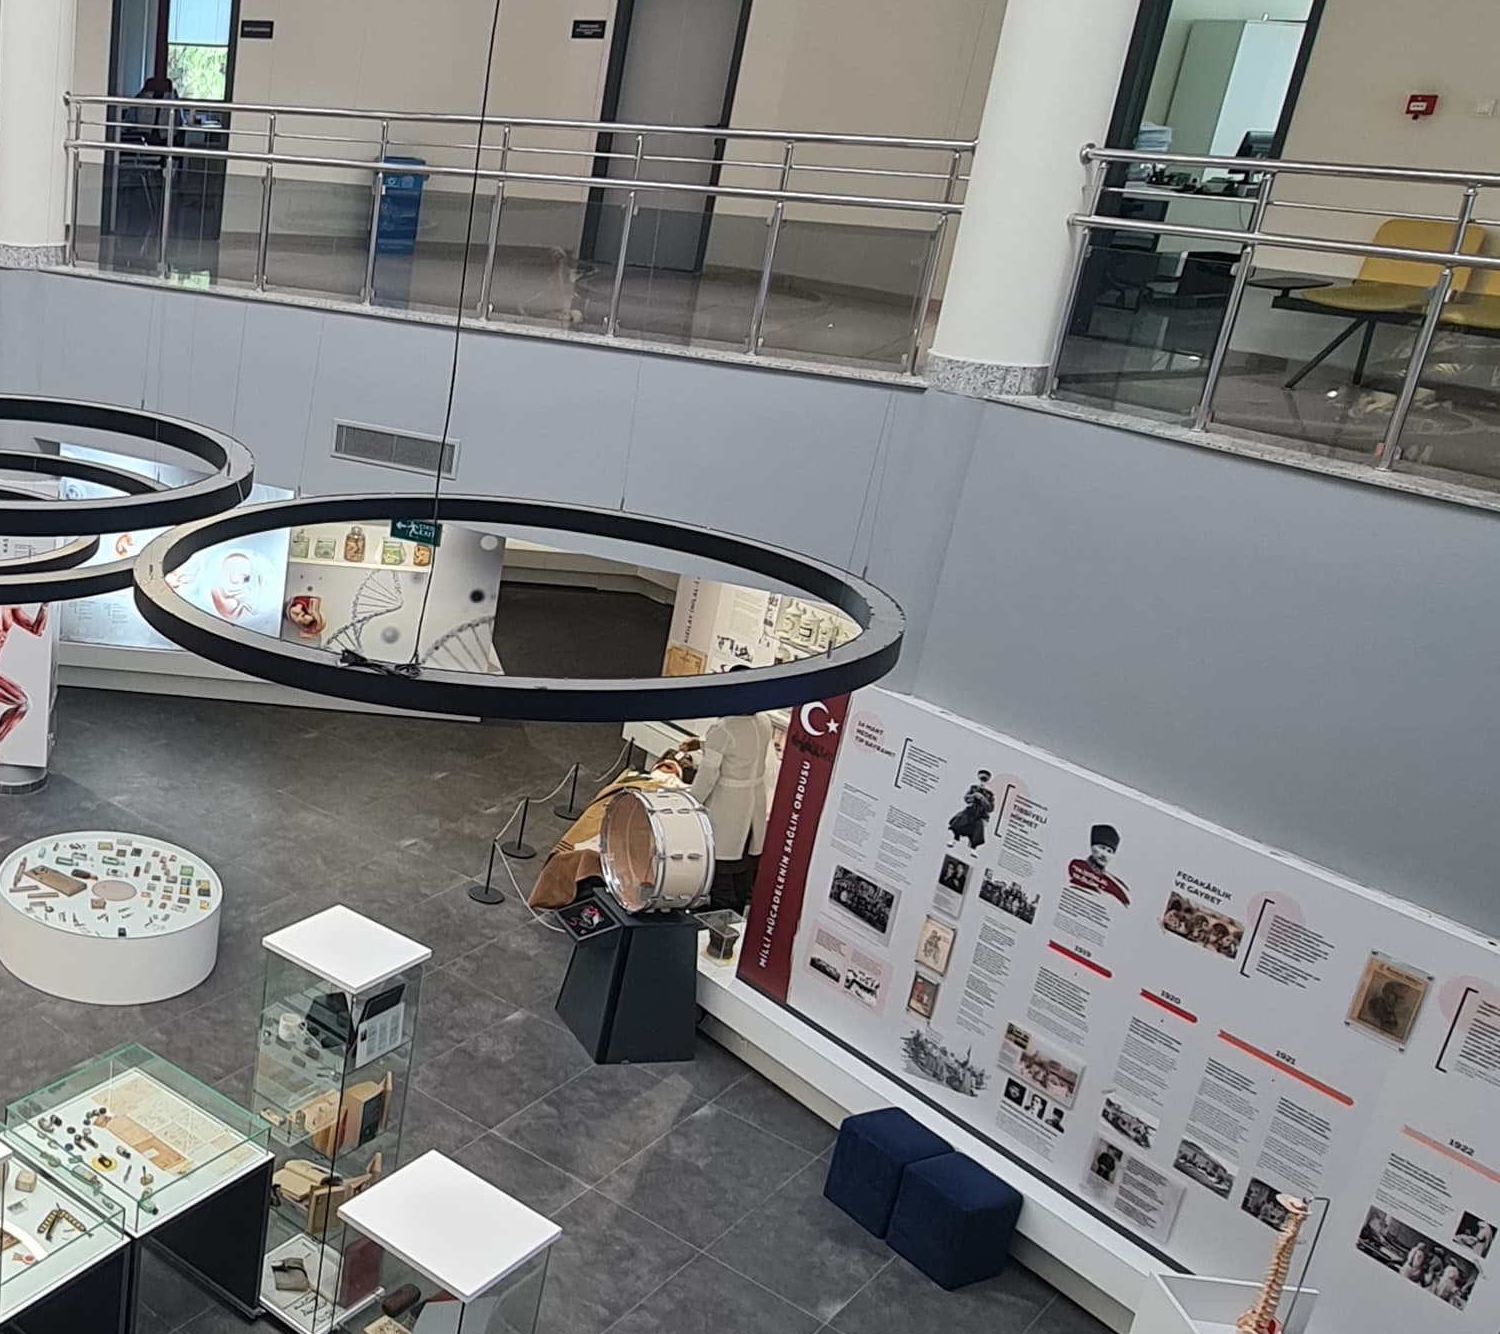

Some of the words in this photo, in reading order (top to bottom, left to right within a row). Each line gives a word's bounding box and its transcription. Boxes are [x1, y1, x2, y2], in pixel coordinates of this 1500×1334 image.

[794, 760, 812, 811] ORDUSU
[784, 811, 802, 855] SAĞLIK
[766, 856, 791, 933] MÜCADELENİN
[1176, 869, 1233, 900] FEDAKÂRLIK
[1186, 885, 1222, 906] GAYRET
[759, 934, 774, 969] MİLLİ
[1074, 945, 1092, 958] 1919
[1161, 989, 1182, 1005] 1920
[1275, 1049, 1296, 1066] 1921
[1448, 1137, 1476, 1157] 1922
